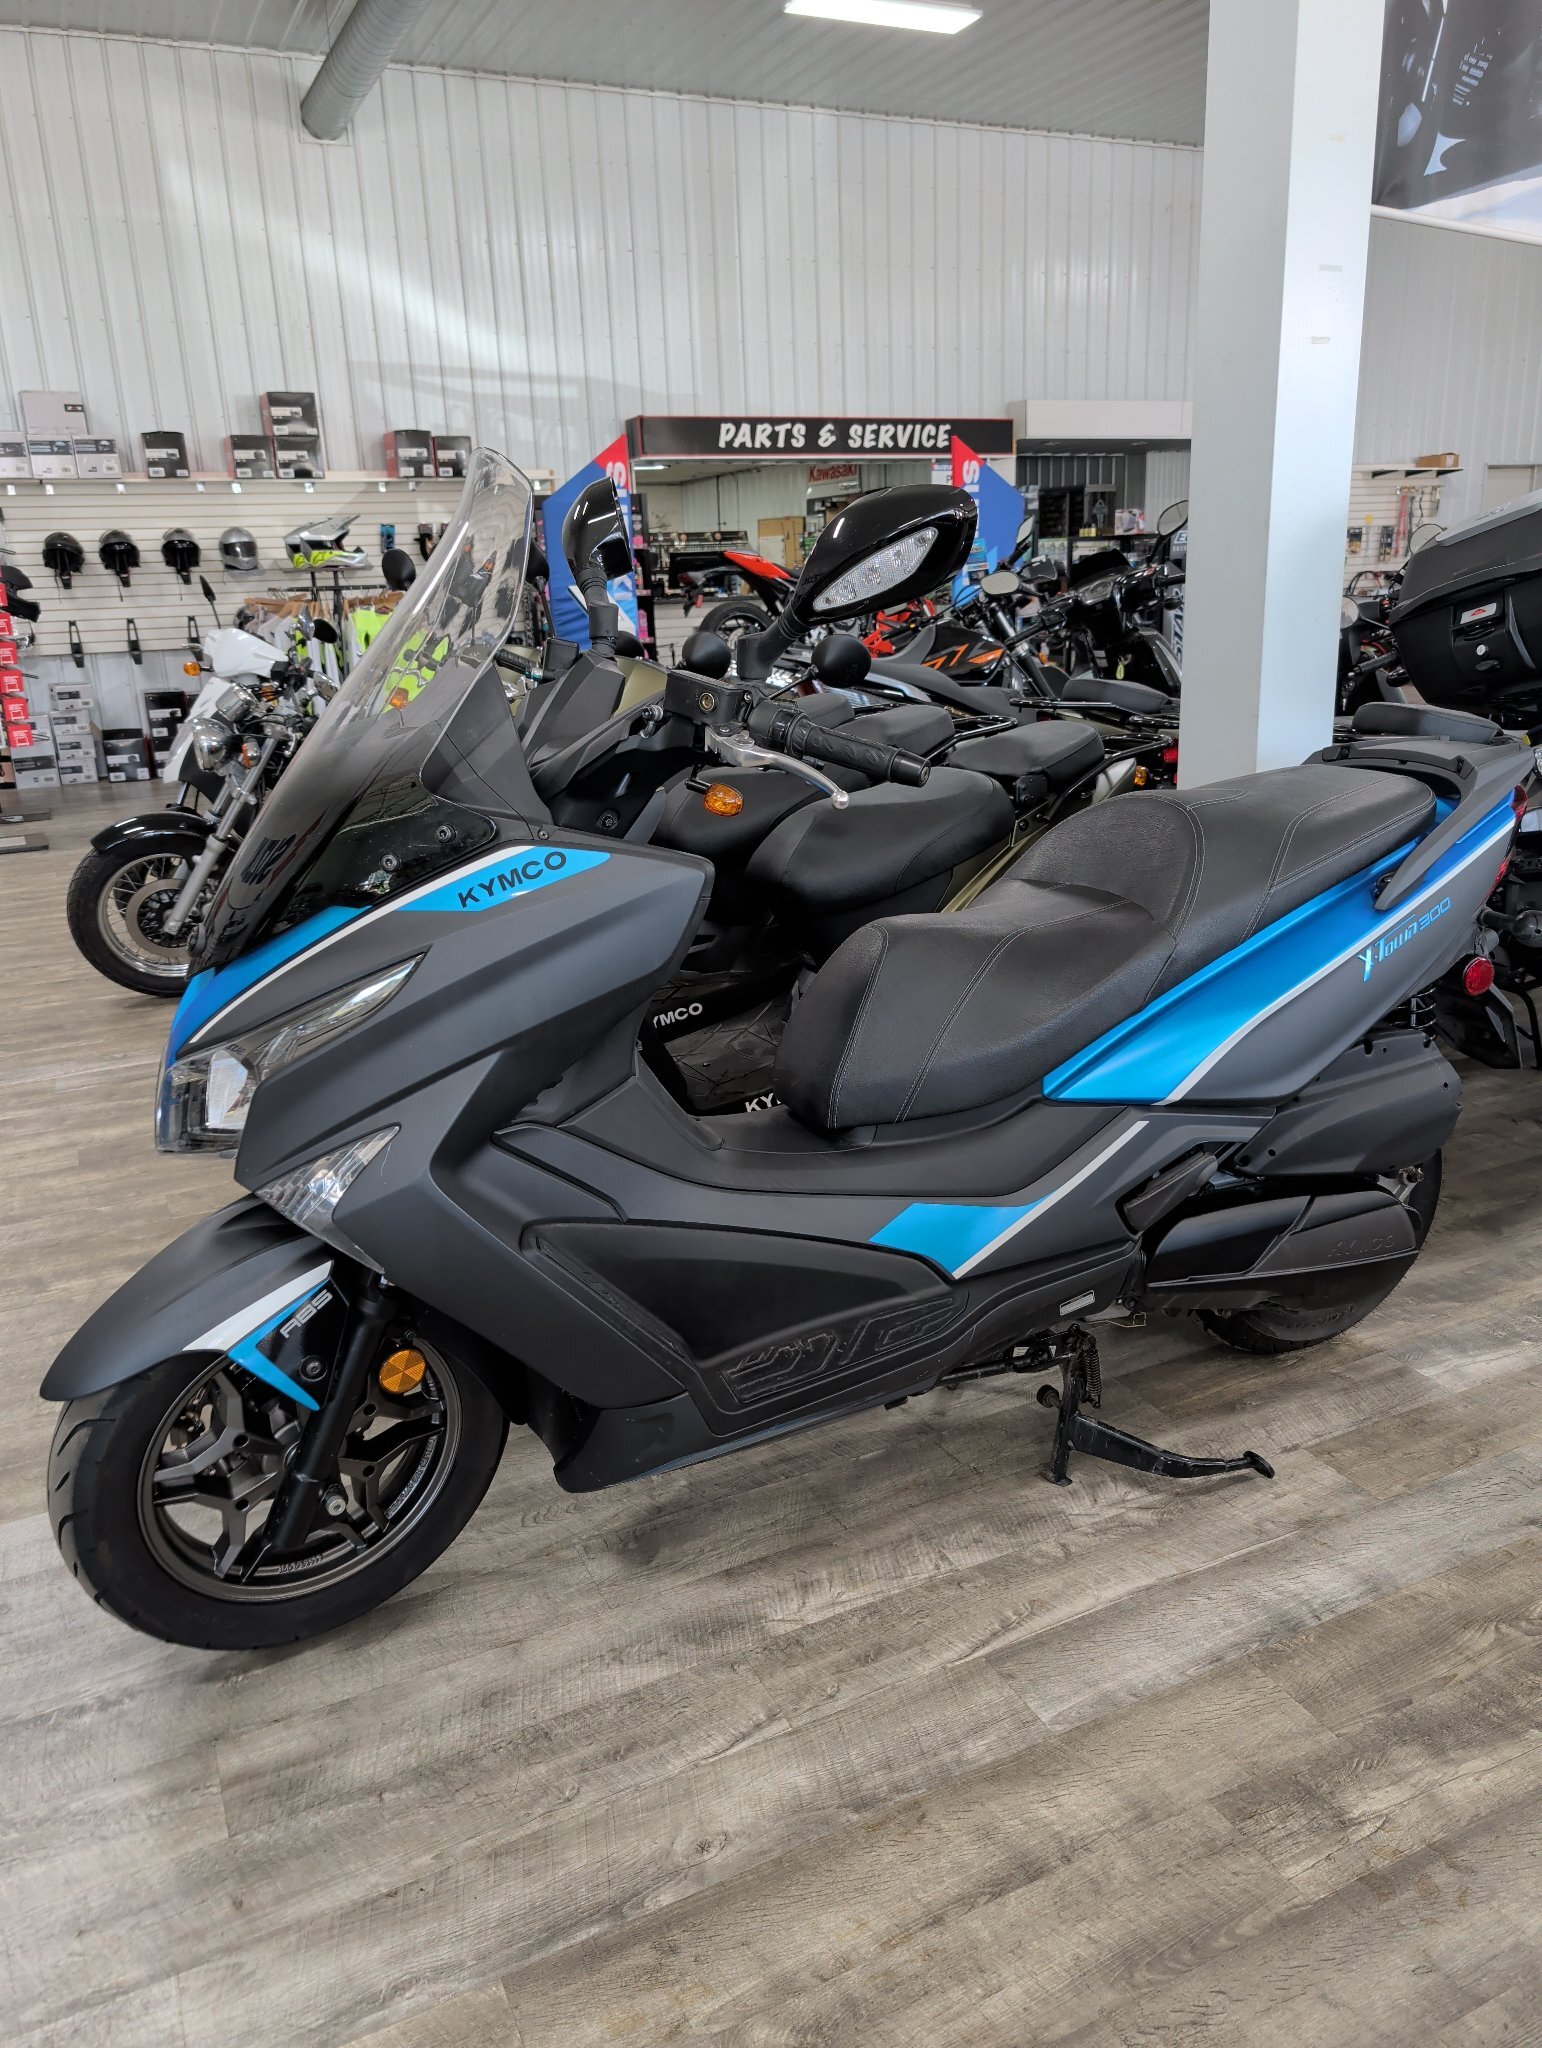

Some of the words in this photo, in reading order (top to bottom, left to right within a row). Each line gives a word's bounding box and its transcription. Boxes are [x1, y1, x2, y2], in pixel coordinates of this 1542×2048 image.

[719, 423, 806, 448] PARTS
[818, 424, 836, 448] &
[848, 424, 951, 448] SERVICE
[458, 851, 567, 908] KYMCO
[280, 1289, 333, 1339] ABS
